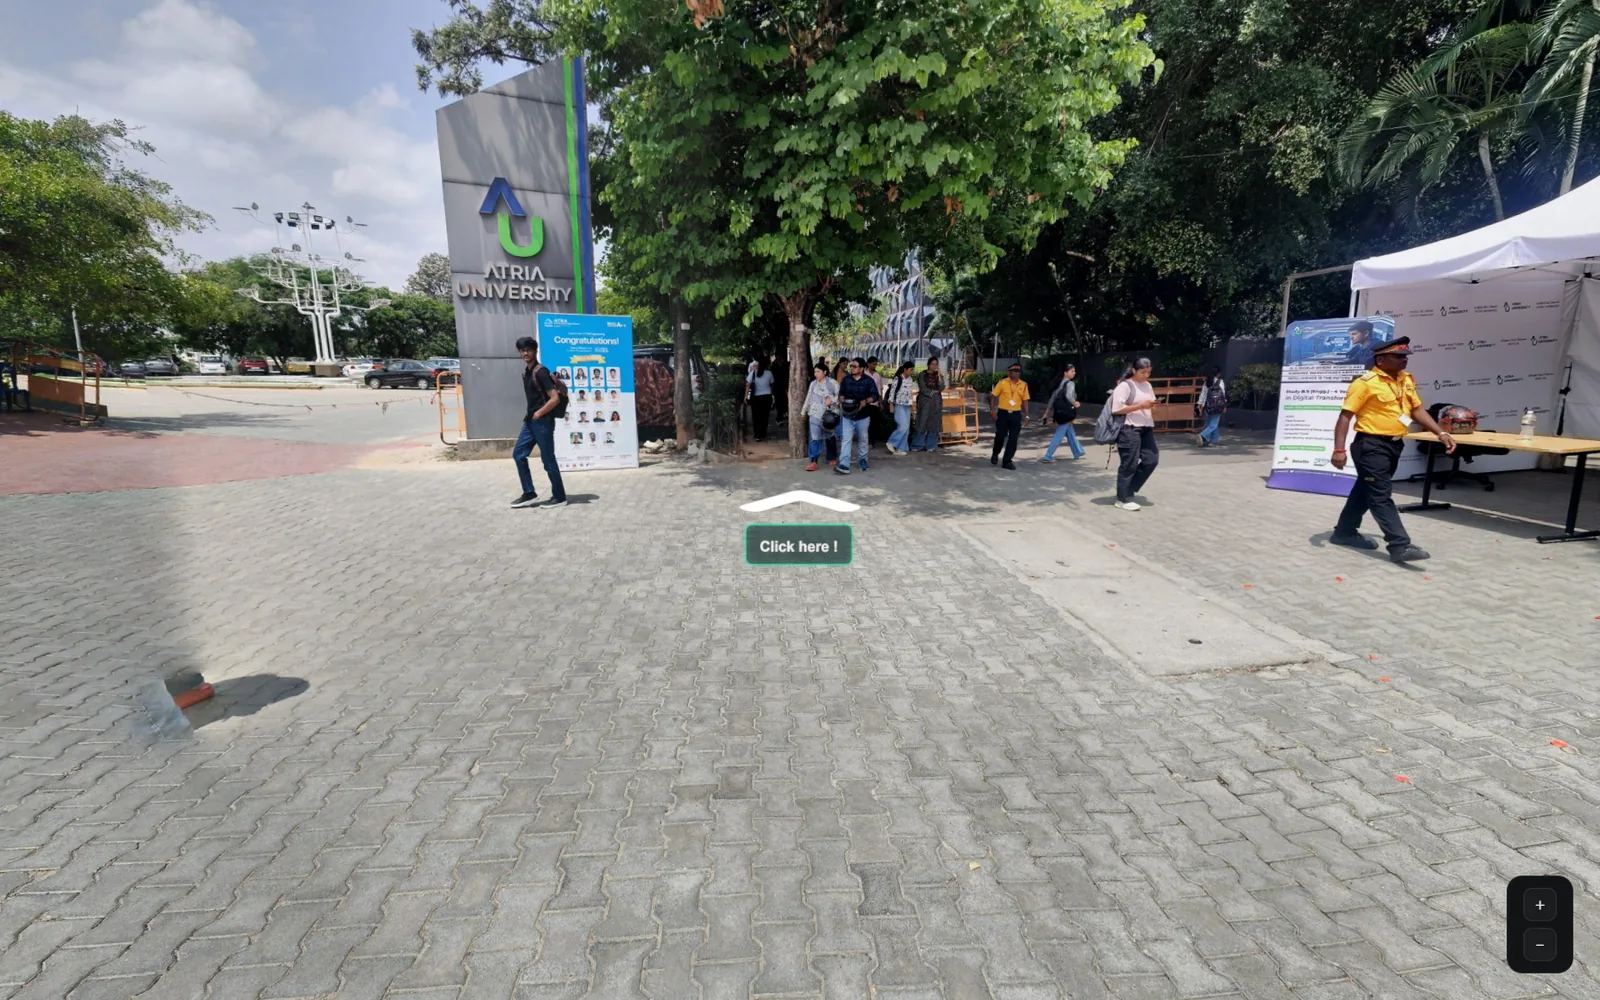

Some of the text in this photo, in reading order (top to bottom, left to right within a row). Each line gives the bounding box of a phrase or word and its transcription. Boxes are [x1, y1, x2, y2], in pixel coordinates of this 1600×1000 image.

[484, 263, 545, 282] ATRIA
[456, 280, 572, 302] UNIVERSITY
[554, 335, 619, 346] Congratulations!
